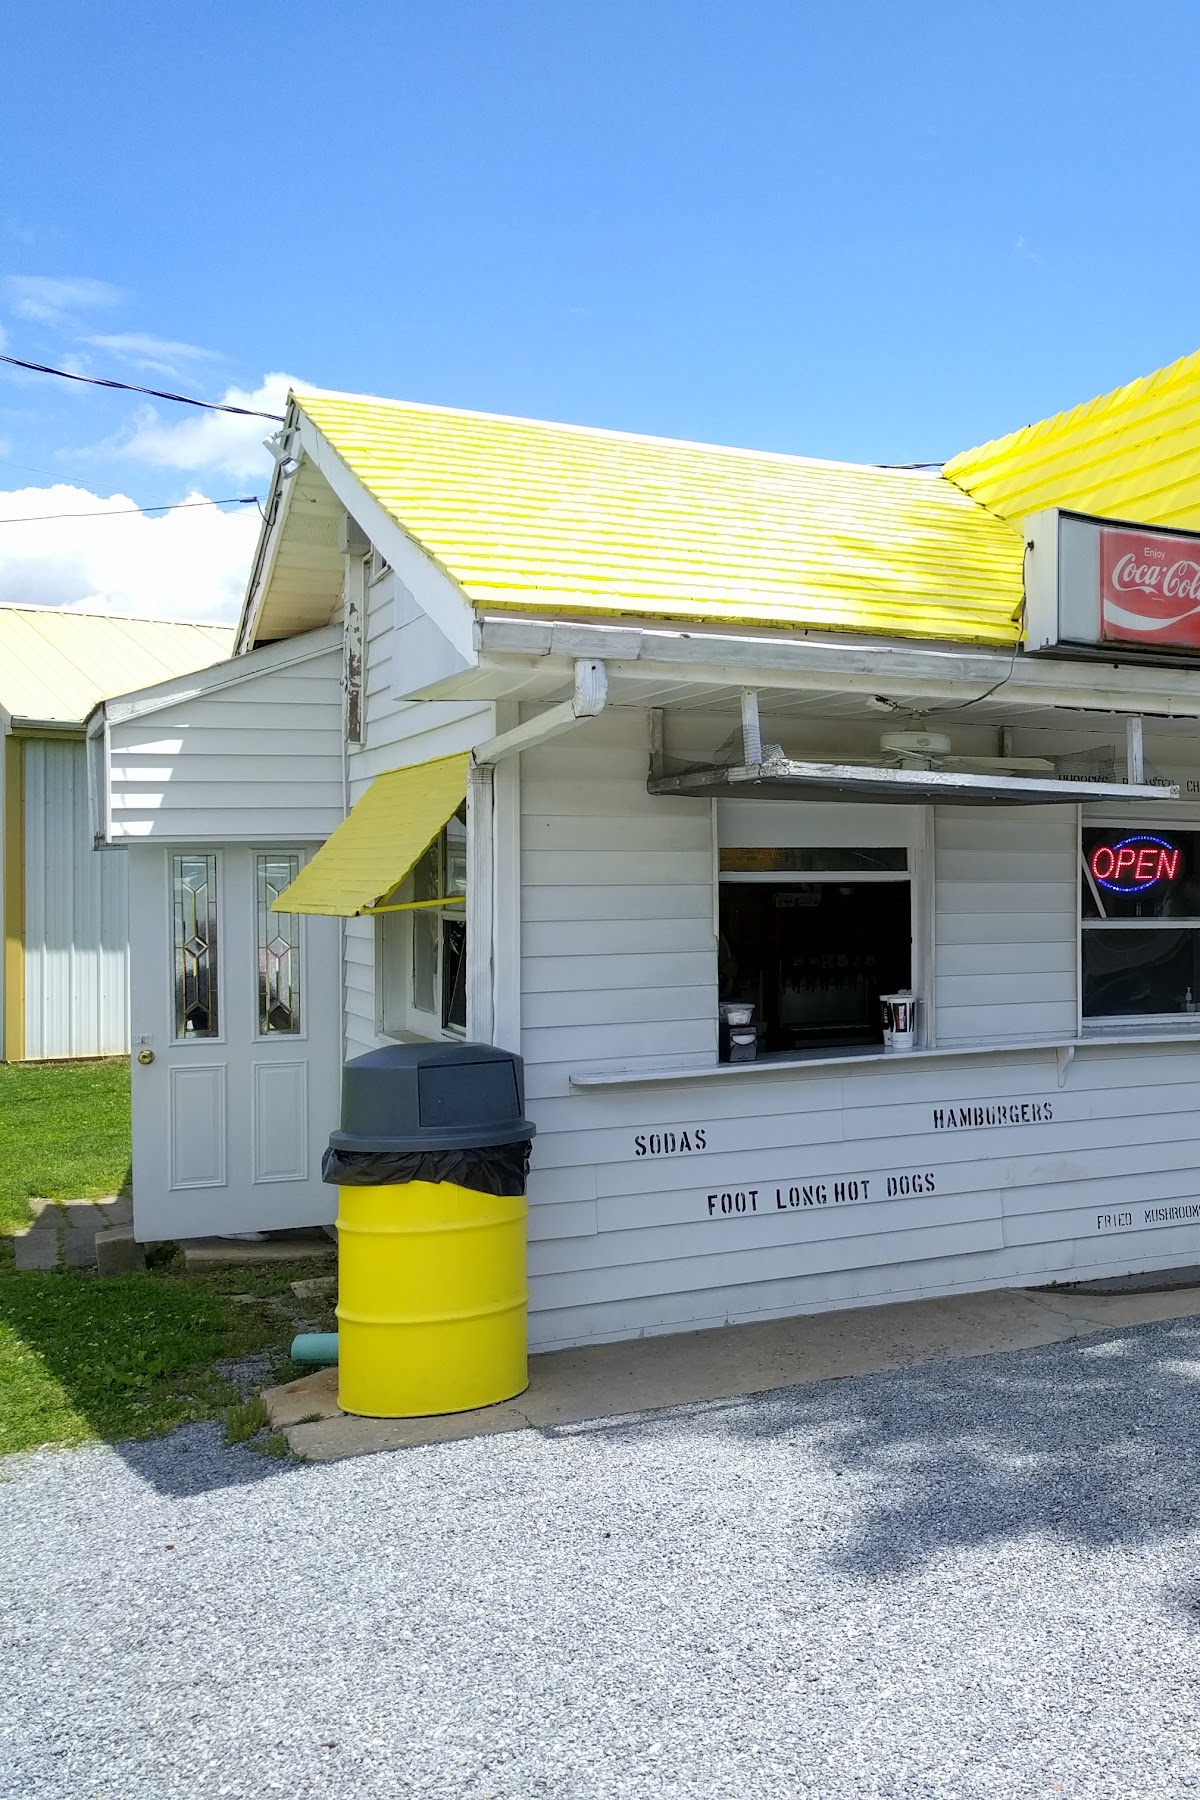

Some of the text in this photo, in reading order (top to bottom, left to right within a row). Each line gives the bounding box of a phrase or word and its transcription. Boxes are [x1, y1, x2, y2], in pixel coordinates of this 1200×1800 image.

[1144, 547, 1166, 560] Enjoy
[1091, 847, 1179, 880] OPEN
[933, 1101, 1054, 1129] HAMBURGERS
[634, 1128, 708, 1156] SODAS
[707, 1173, 936, 1216] FOOT LONG HOT DOGS
[1097, 1212, 1132, 1229] FRIED
